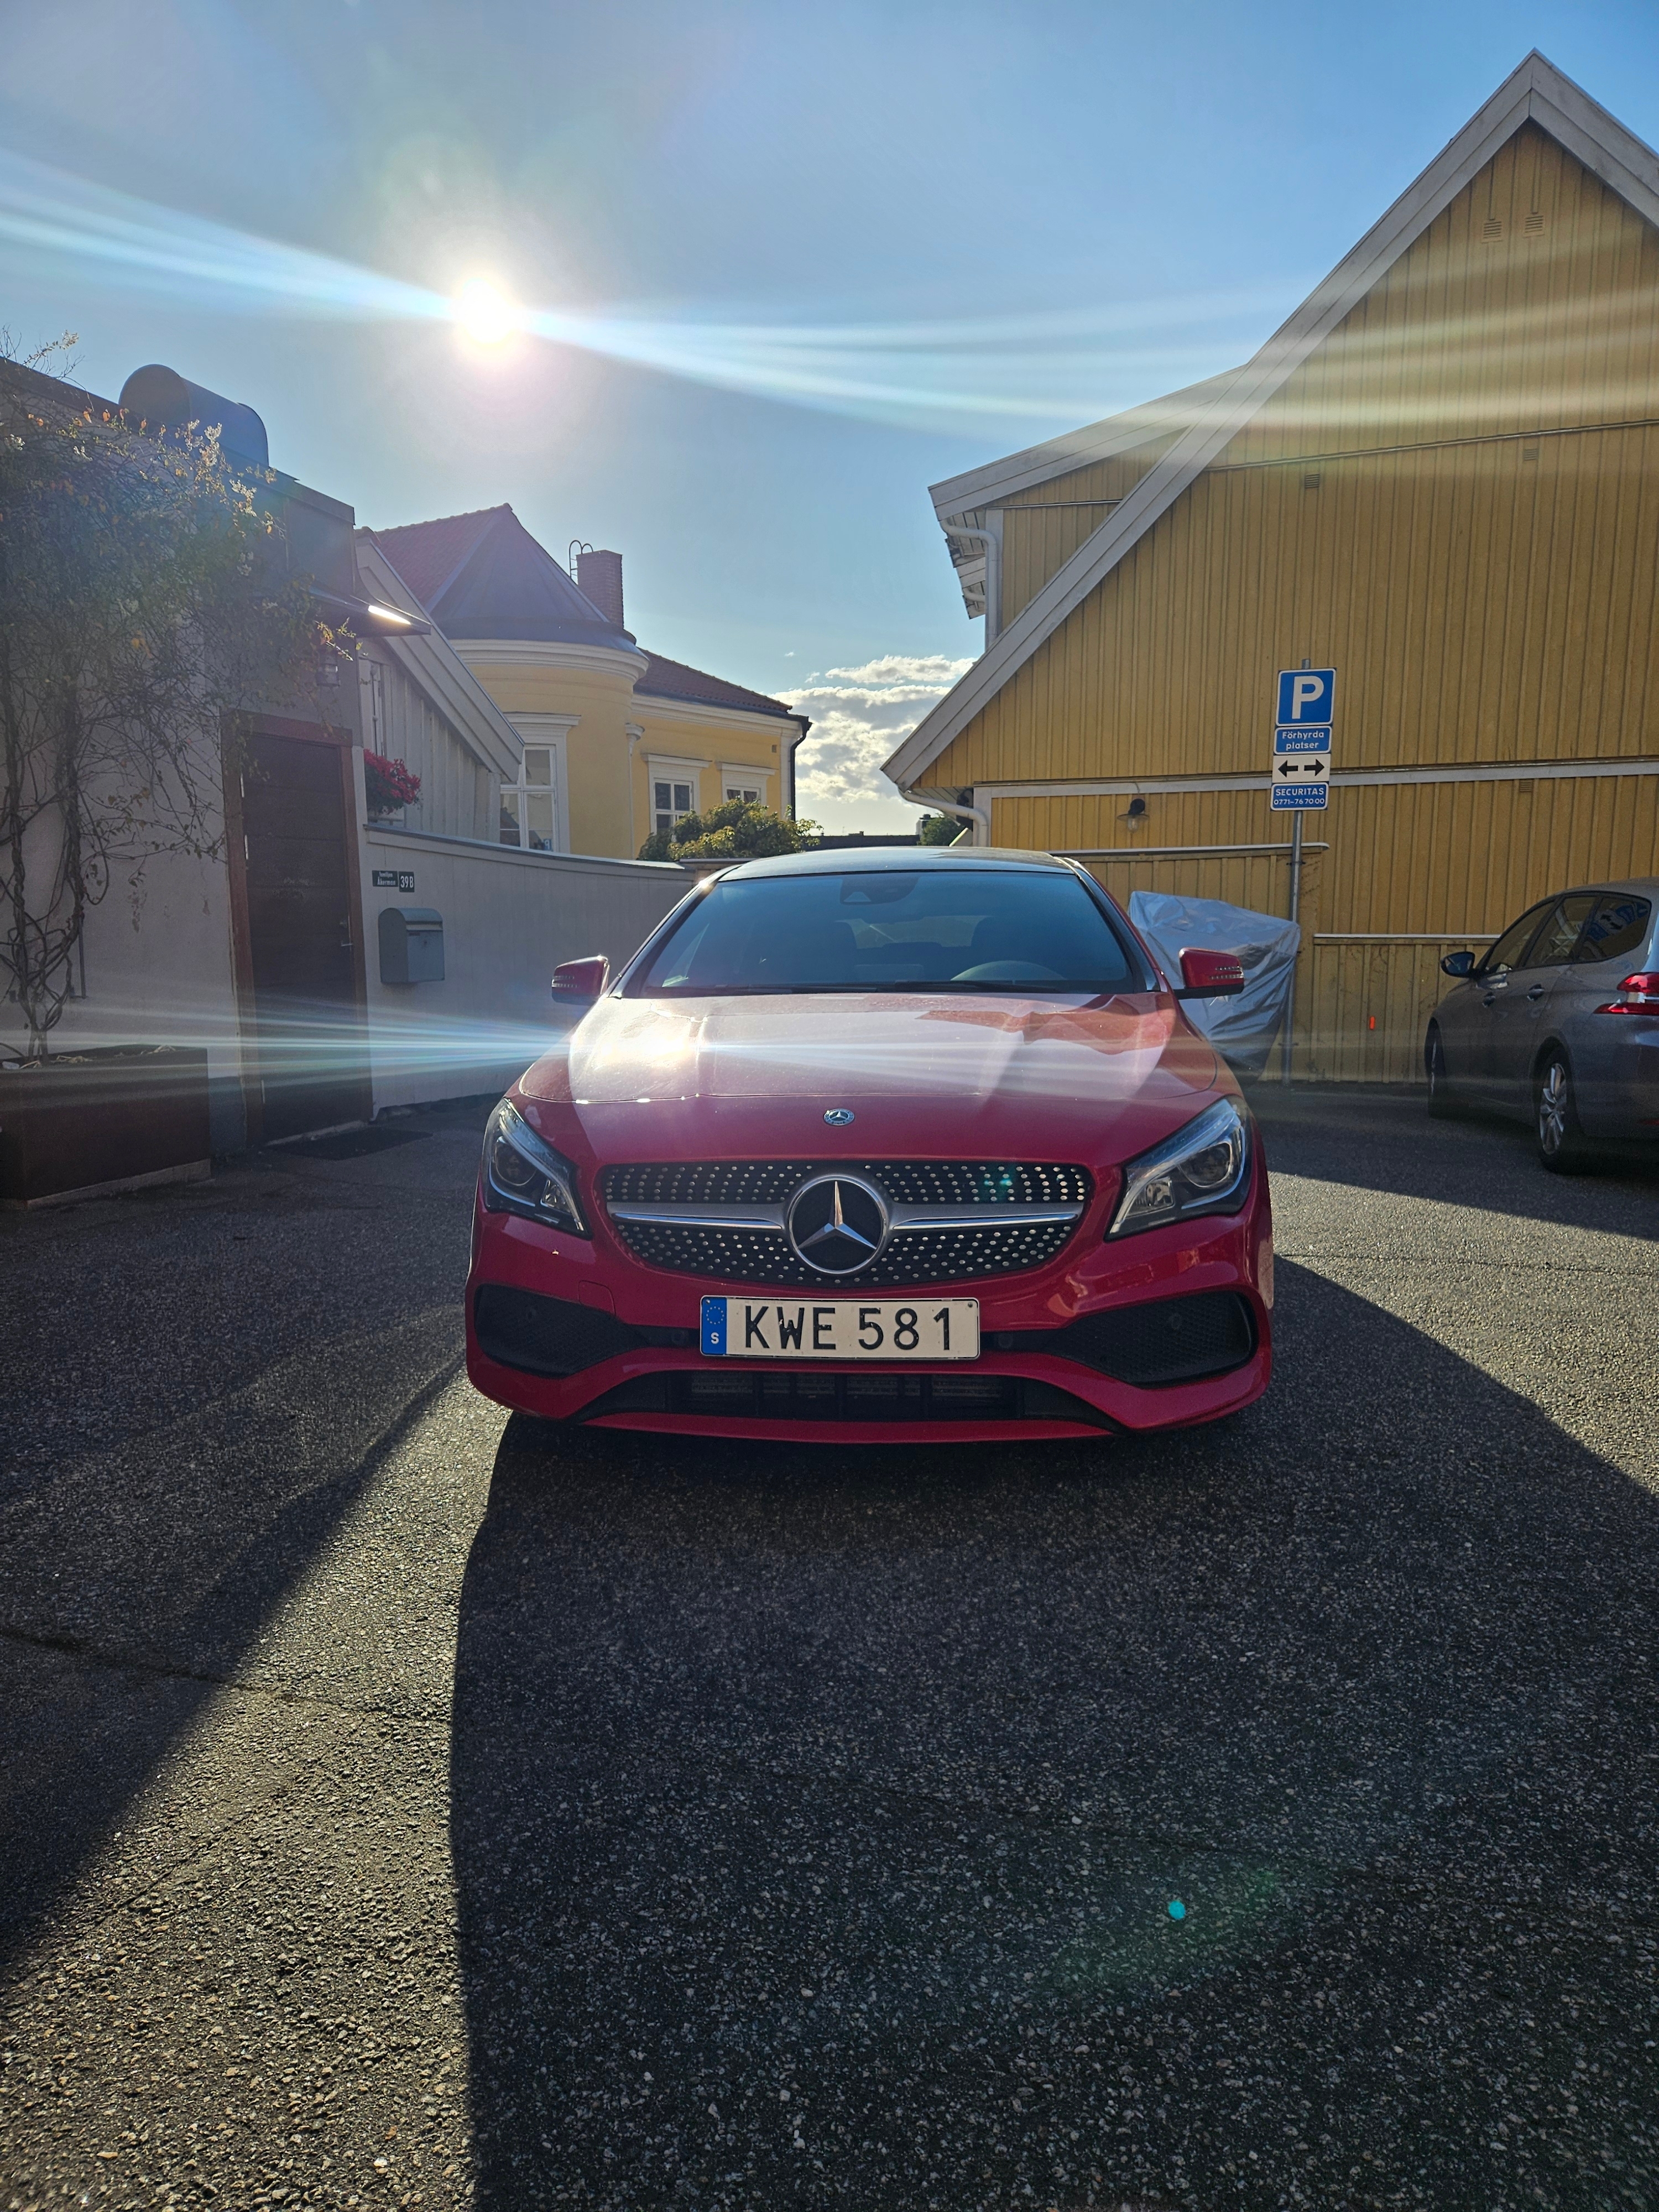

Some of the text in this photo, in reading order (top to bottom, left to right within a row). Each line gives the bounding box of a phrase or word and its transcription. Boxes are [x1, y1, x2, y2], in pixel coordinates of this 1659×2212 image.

[1291, 675, 1324, 719] P
[1282, 731, 1324, 740] Förhyrda
[1286, 742, 1319, 751] platser
[1275, 787, 1324, 796] SECURITAS
[400, 875, 414, 888] 39B
[745, 1305, 950, 1350] KWE 581
[711, 1332, 719, 1344] S
